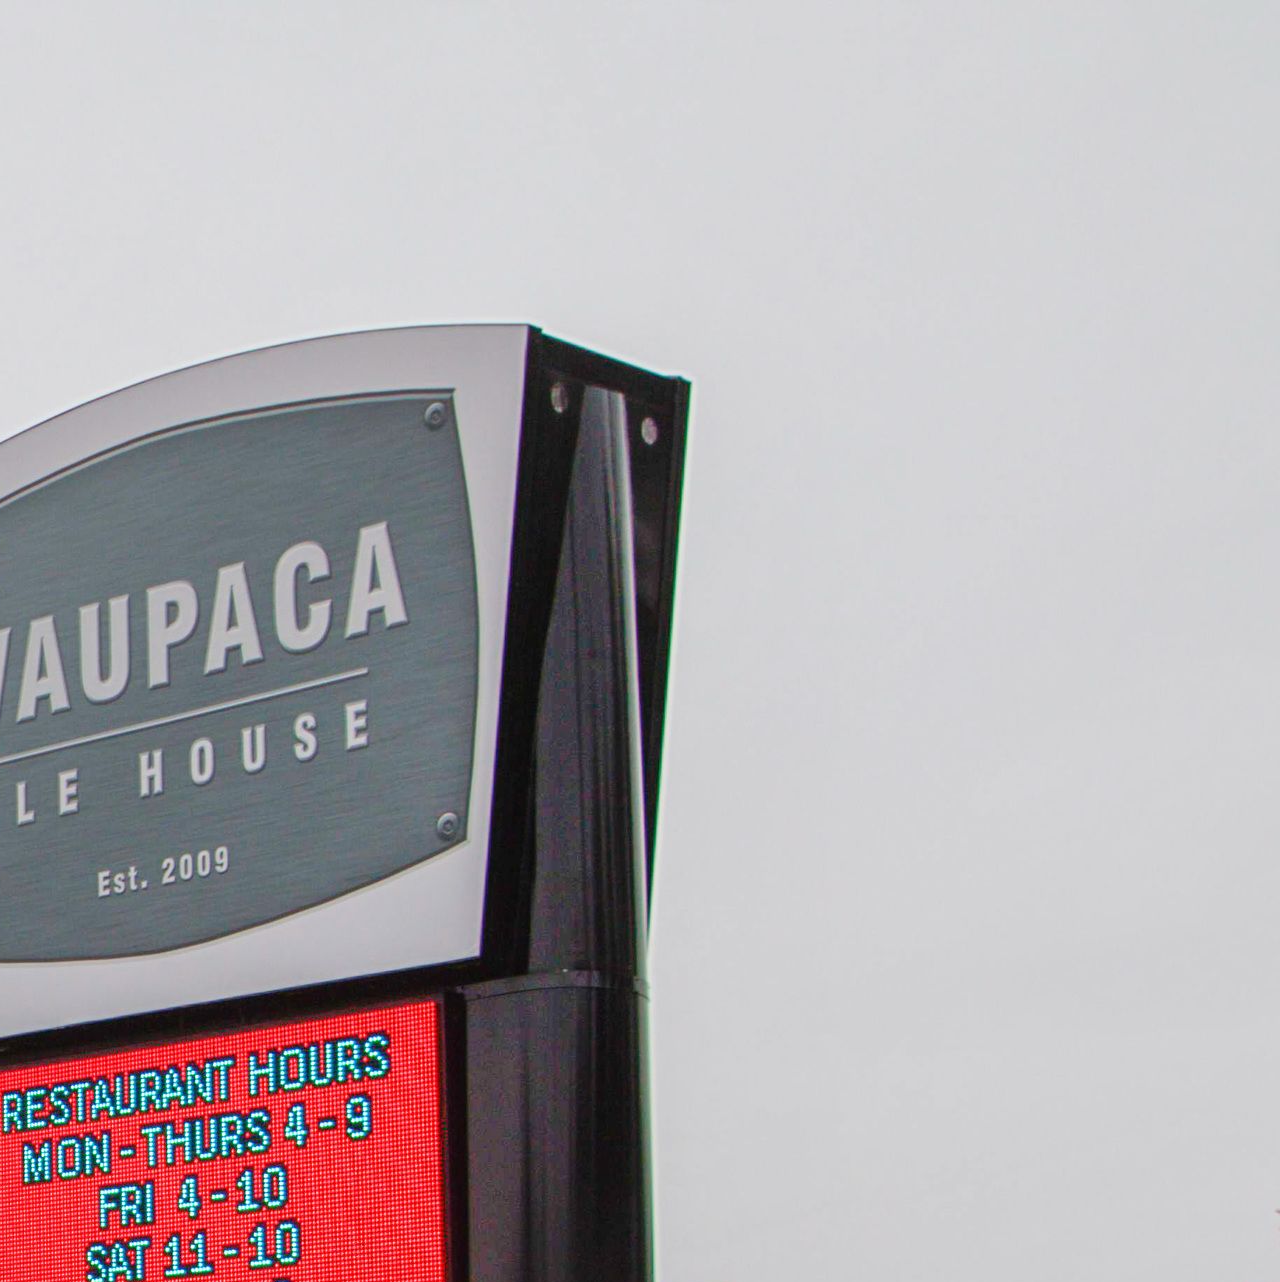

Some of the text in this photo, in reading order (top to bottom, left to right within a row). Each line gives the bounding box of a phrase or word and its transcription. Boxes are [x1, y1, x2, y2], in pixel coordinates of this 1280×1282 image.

[139, 700, 370, 798] HOUSE
[97, 846, 230, 899] Est. 2009
[1, 1031, 392, 1134] RESTAURANT HOURS
[98, 1180, 156, 1229] FRI
